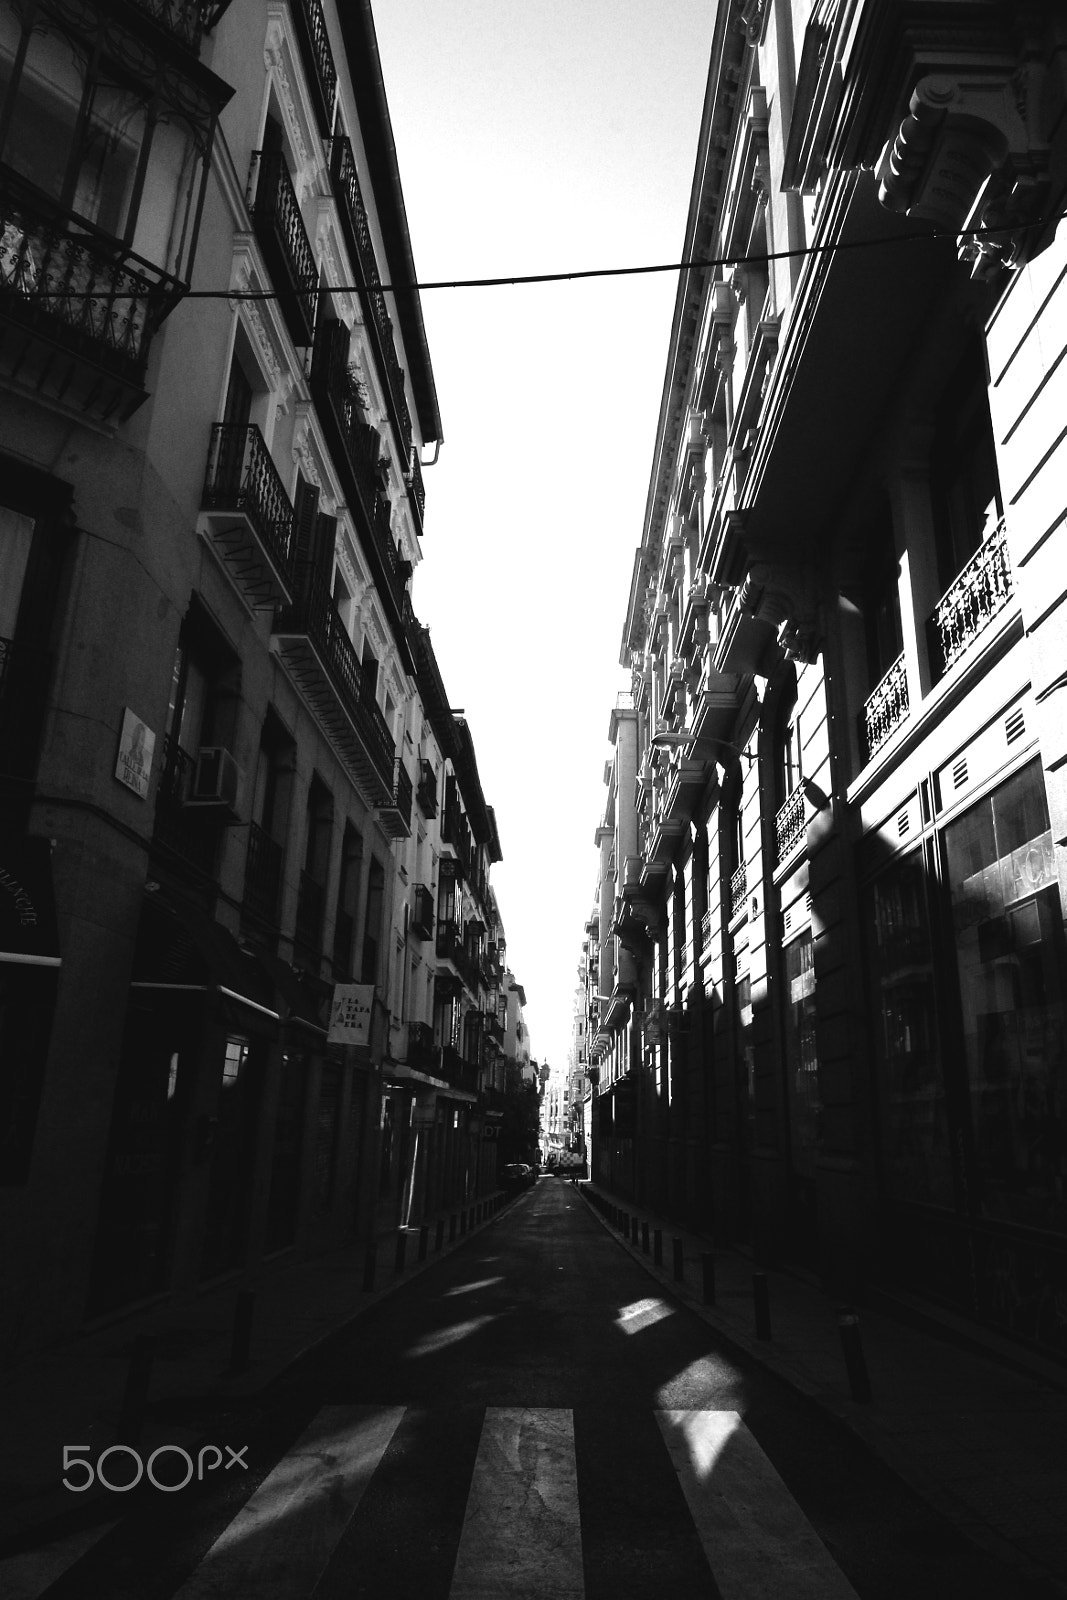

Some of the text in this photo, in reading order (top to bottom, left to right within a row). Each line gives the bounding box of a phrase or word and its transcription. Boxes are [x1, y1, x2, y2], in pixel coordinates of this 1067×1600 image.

[120, 751, 137, 772] CALLE
[346, 1005, 371, 1013] TAPA
[344, 1021, 363, 1029] ERA
